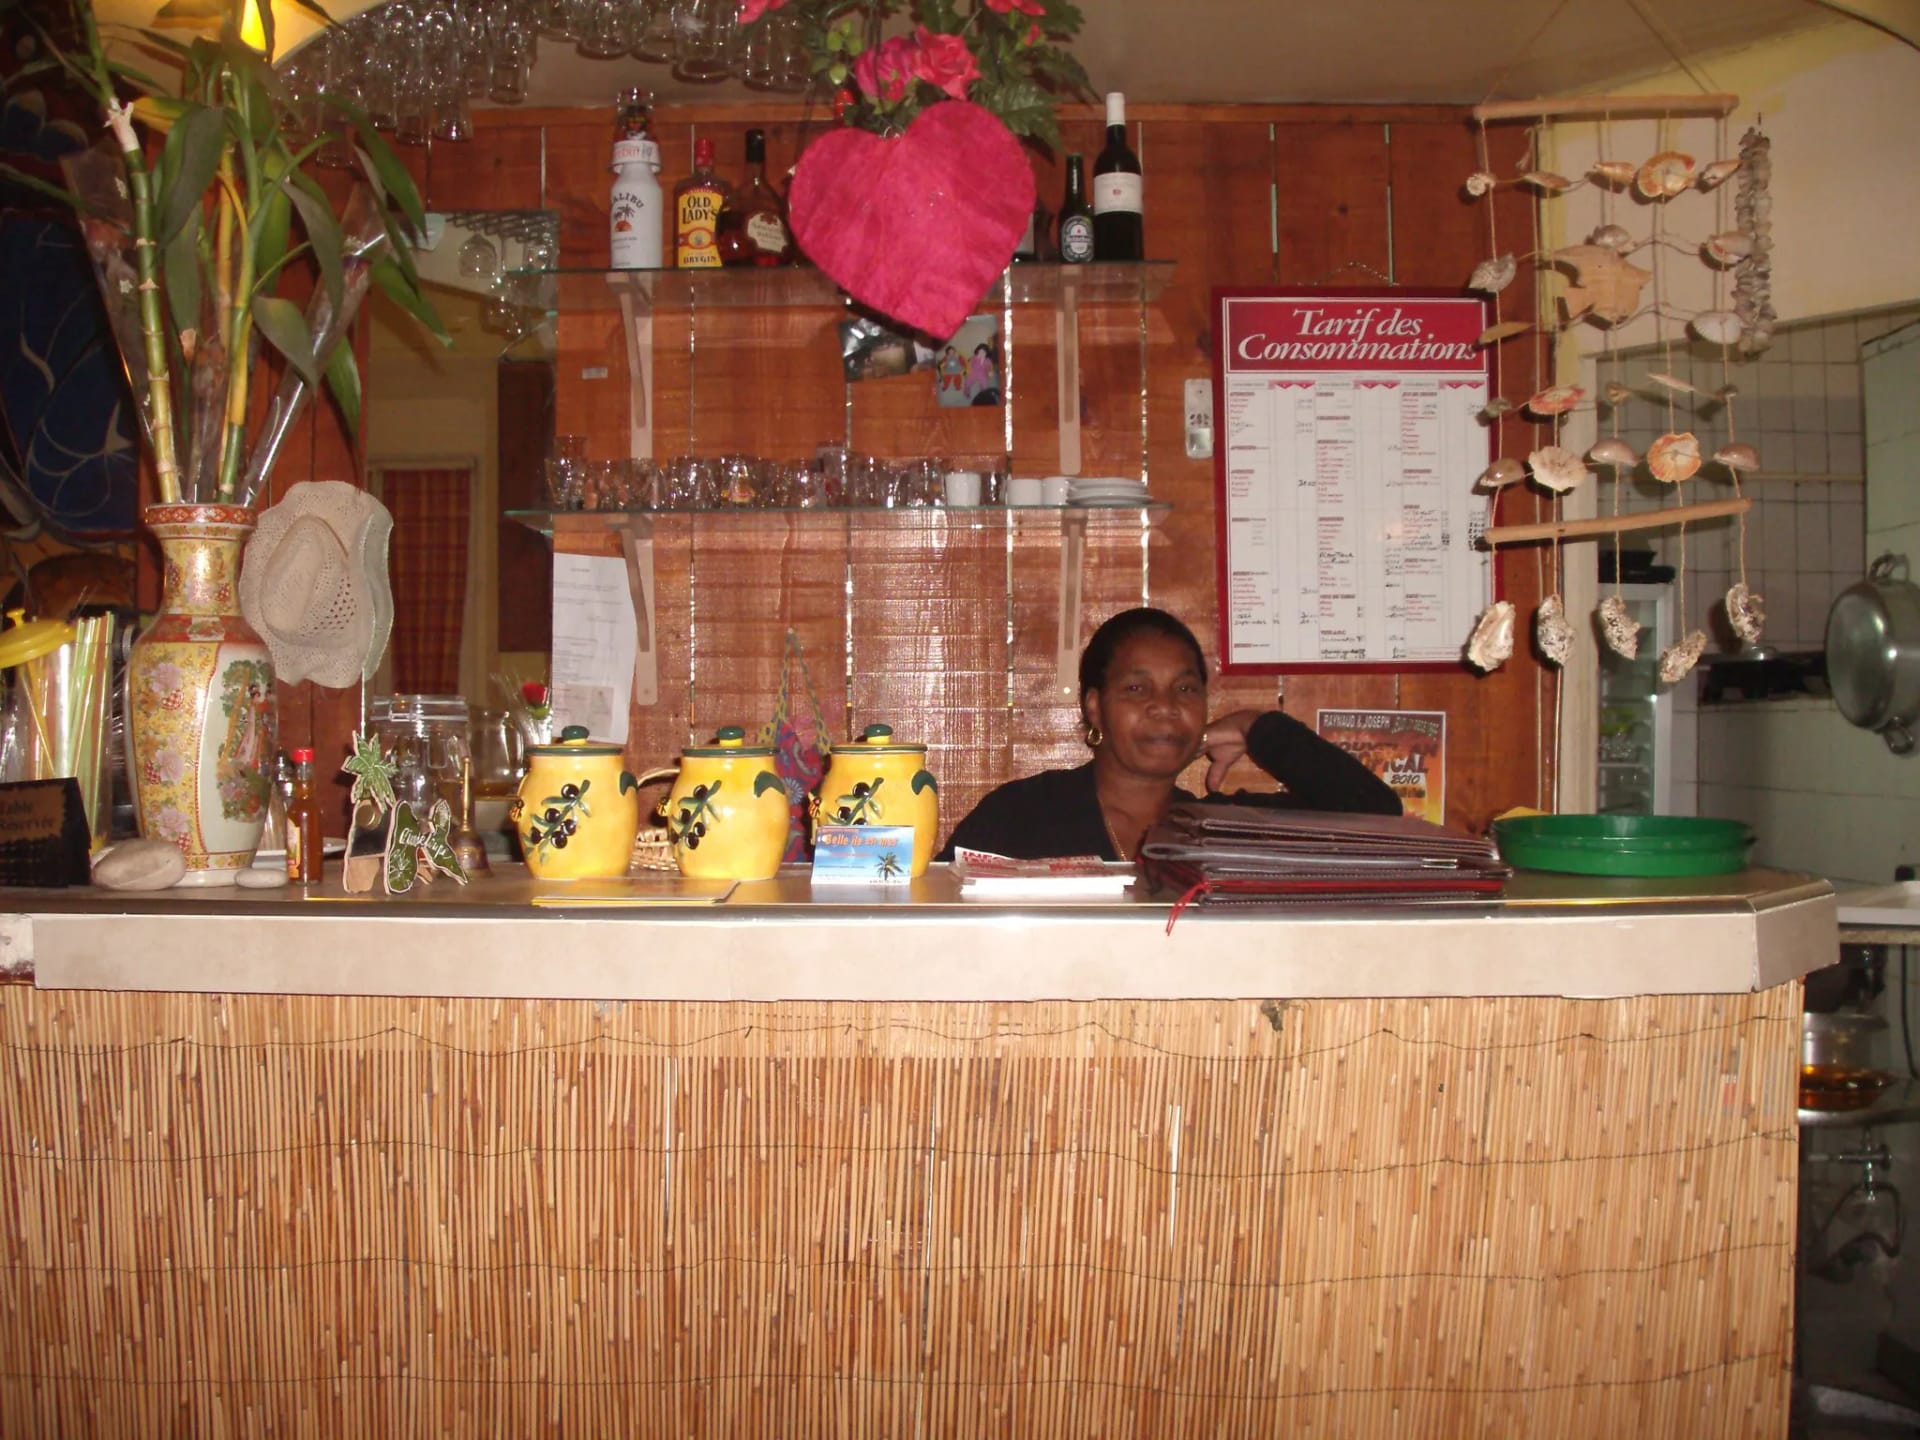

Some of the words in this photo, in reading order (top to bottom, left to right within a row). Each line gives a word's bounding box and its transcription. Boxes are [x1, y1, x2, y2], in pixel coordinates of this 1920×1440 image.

[687, 195, 712, 208] OLD
[682, 207, 718, 224] LADY'S
[683, 256, 701, 264] DRY
[702, 255, 717, 264] GIN
[1293, 308, 1380, 342] Tarif
[1376, 308, 1423, 336] des
[1237, 333, 1477, 361] Consommations
[1323, 714, 1356, 728] RAYNAUD
[1364, 715, 1391, 728] JOSEPH
[1391, 774, 1421, 784] 2010
